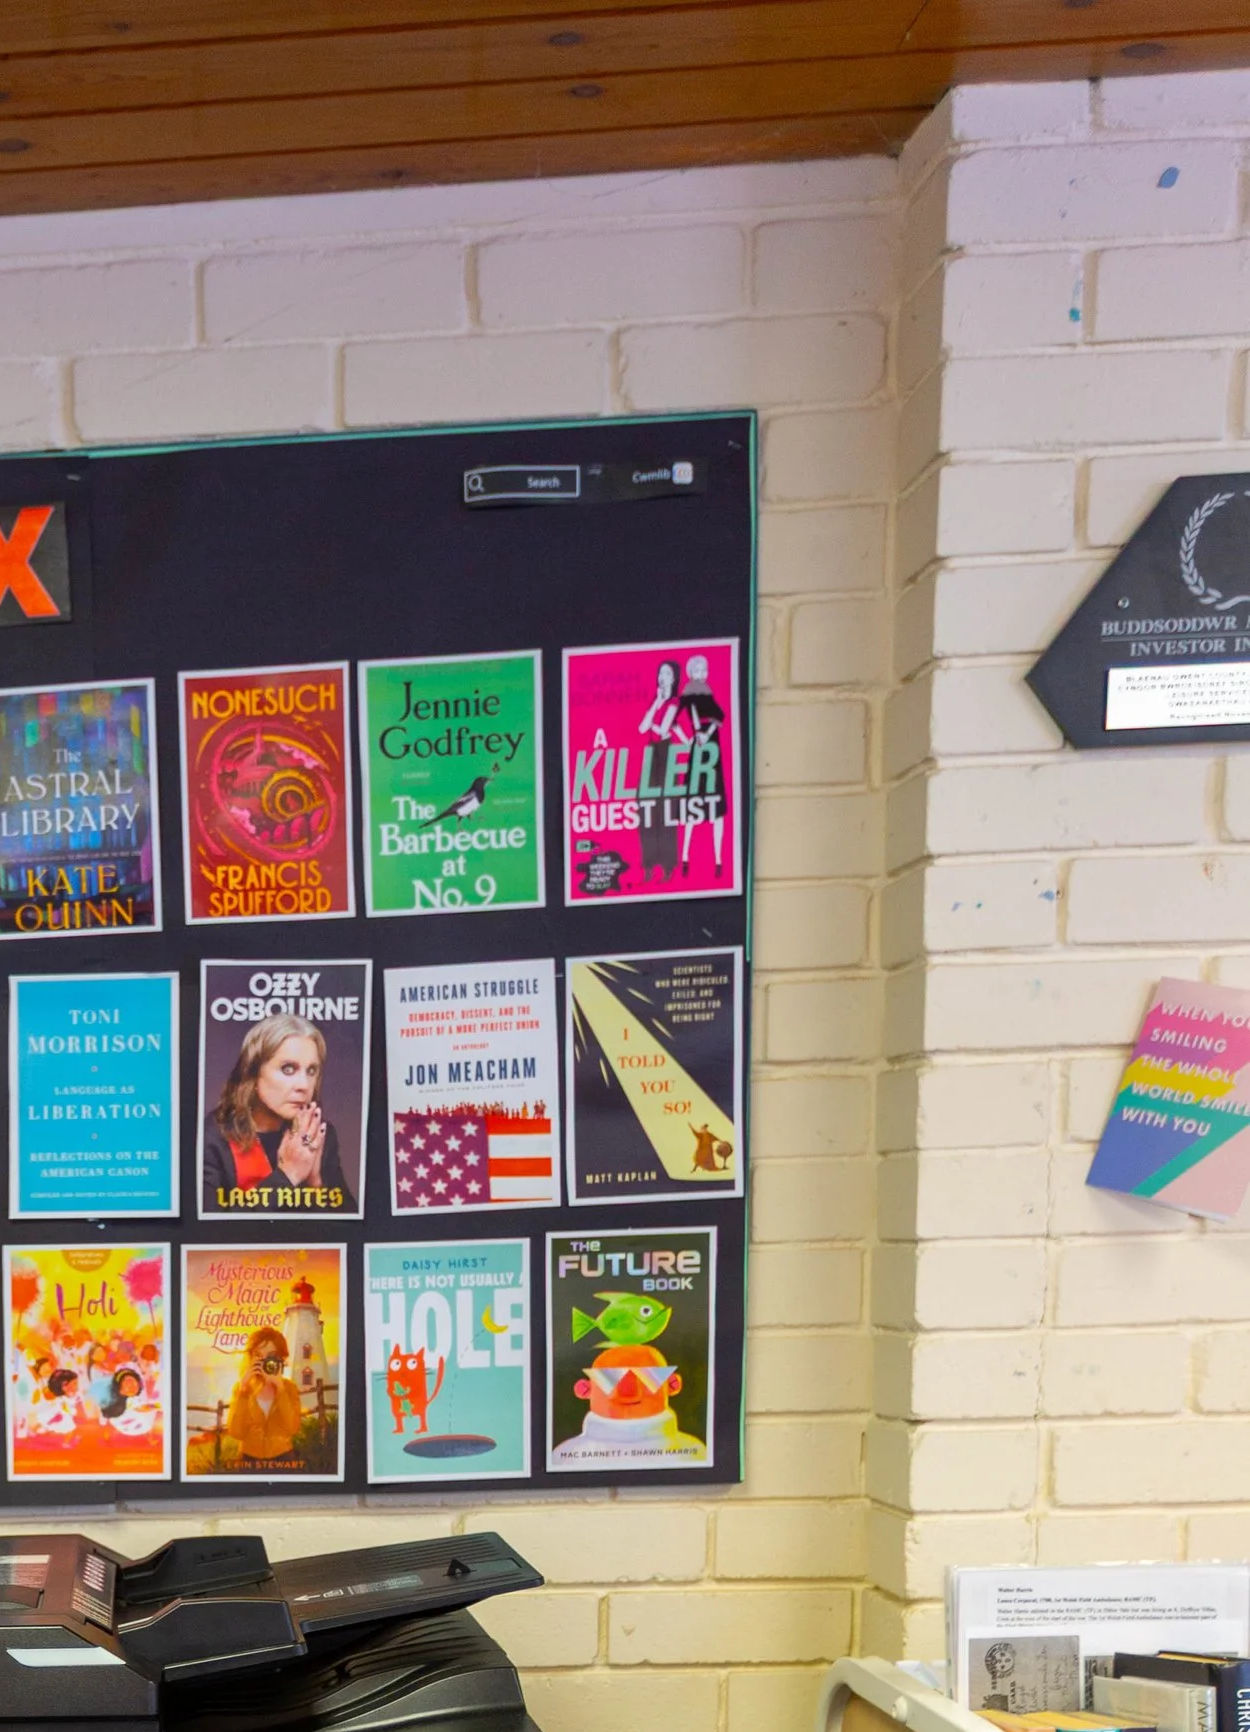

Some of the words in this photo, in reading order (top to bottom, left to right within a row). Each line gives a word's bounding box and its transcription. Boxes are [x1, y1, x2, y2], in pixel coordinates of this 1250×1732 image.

[527, 476, 560, 489] Search
[1100, 615, 1237, 636] BUDDSODDWR
[1130, 639, 1227, 657] INVESTOR
[191, 682, 336, 719] NONESUCH
[399, 681, 501, 722] Jennie
[379, 726, 525, 761] Godfrey
[593, 728, 608, 749] A
[53, 748, 82, 764] The
[573, 740, 720, 803] KILLER
[4, 769, 134, 802] ASTRAL
[1, 803, 141, 837] LIBRARY
[391, 795, 436, 822] The
[572, 800, 656, 833] GUEST
[664, 795, 722, 828] LIST
[379, 824, 526, 856] Barbecue
[216, 859, 323, 889] FRANCIS
[442, 854, 467, 877] at
[27, 865, 119, 898] KATE
[412, 878, 469, 909] No.
[474, 874, 497, 906] 9
[209, 885, 332, 916] SPUFFORD
[15, 899, 135, 933] QUINN
[249, 972, 320, 997] OZZY
[400, 983, 467, 1003] AMERICAN
[474, 979, 539, 998] STRUGGLE
[69, 1008, 120, 1025] TONI
[210, 997, 359, 1022] OSBOURNE
[408, 1010, 456, 1023] DEMOCRACY,
[498, 1006, 514, 1016] AND
[517, 1005, 531, 1015] THE
[1160, 1001, 1217, 1022] WHEN
[28, 1034, 162, 1055] MORRISON
[400, 1027, 433, 1038] PURSUIT
[1151, 1027, 1227, 1053] SMILING
[405, 1063, 438, 1086] JON
[448, 1057, 536, 1084] MEACHAM
[618, 1055, 665, 1070] TOLD
[1140, 1053, 1172, 1072] THE
[1176, 1060, 1240, 1085] WHOLE
[54, 1085, 116, 1096] LANGUAGE
[120, 1085, 135, 1095] AS
[640, 1081, 676, 1095] YOU
[1131, 1081, 1195, 1105] WORLD
[28, 1103, 161, 1121] LIBERATION
[663, 1101, 692, 1115] SO!
[1122, 1106, 1168, 1128] WITH
[1172, 1114, 1212, 1136] YOU
[30, 1151, 112, 1162] REFLECTIONS
[40, 1167, 104, 1178] AMERICAN
[586, 1173, 612, 1184] MATT
[618, 1171, 657, 1183] KAPLAN
[216, 1186, 273, 1208] LAST
[276, 1186, 344, 1208] RITES
[202, 1262, 293, 1288] Mysterious
[402, 1260, 441, 1270] DAISY
[448, 1257, 488, 1268] HIRST
[408, 1275, 420, 1288] IS
[425, 1274, 455, 1288] NOT
[460, 1272, 514, 1286] USUALLY
[642, 1277, 693, 1291] BOOK
[56, 1280, 118, 1320] Holi
[208, 1283, 281, 1313] Magic
[195, 1306, 282, 1334] Lighthouse
[368, 1287, 525, 1371] HOLE
[212, 1330, 249, 1354] Lane
[256, 1459, 306, 1470] STEWART
[581, 1449, 621, 1458] BARNETT
